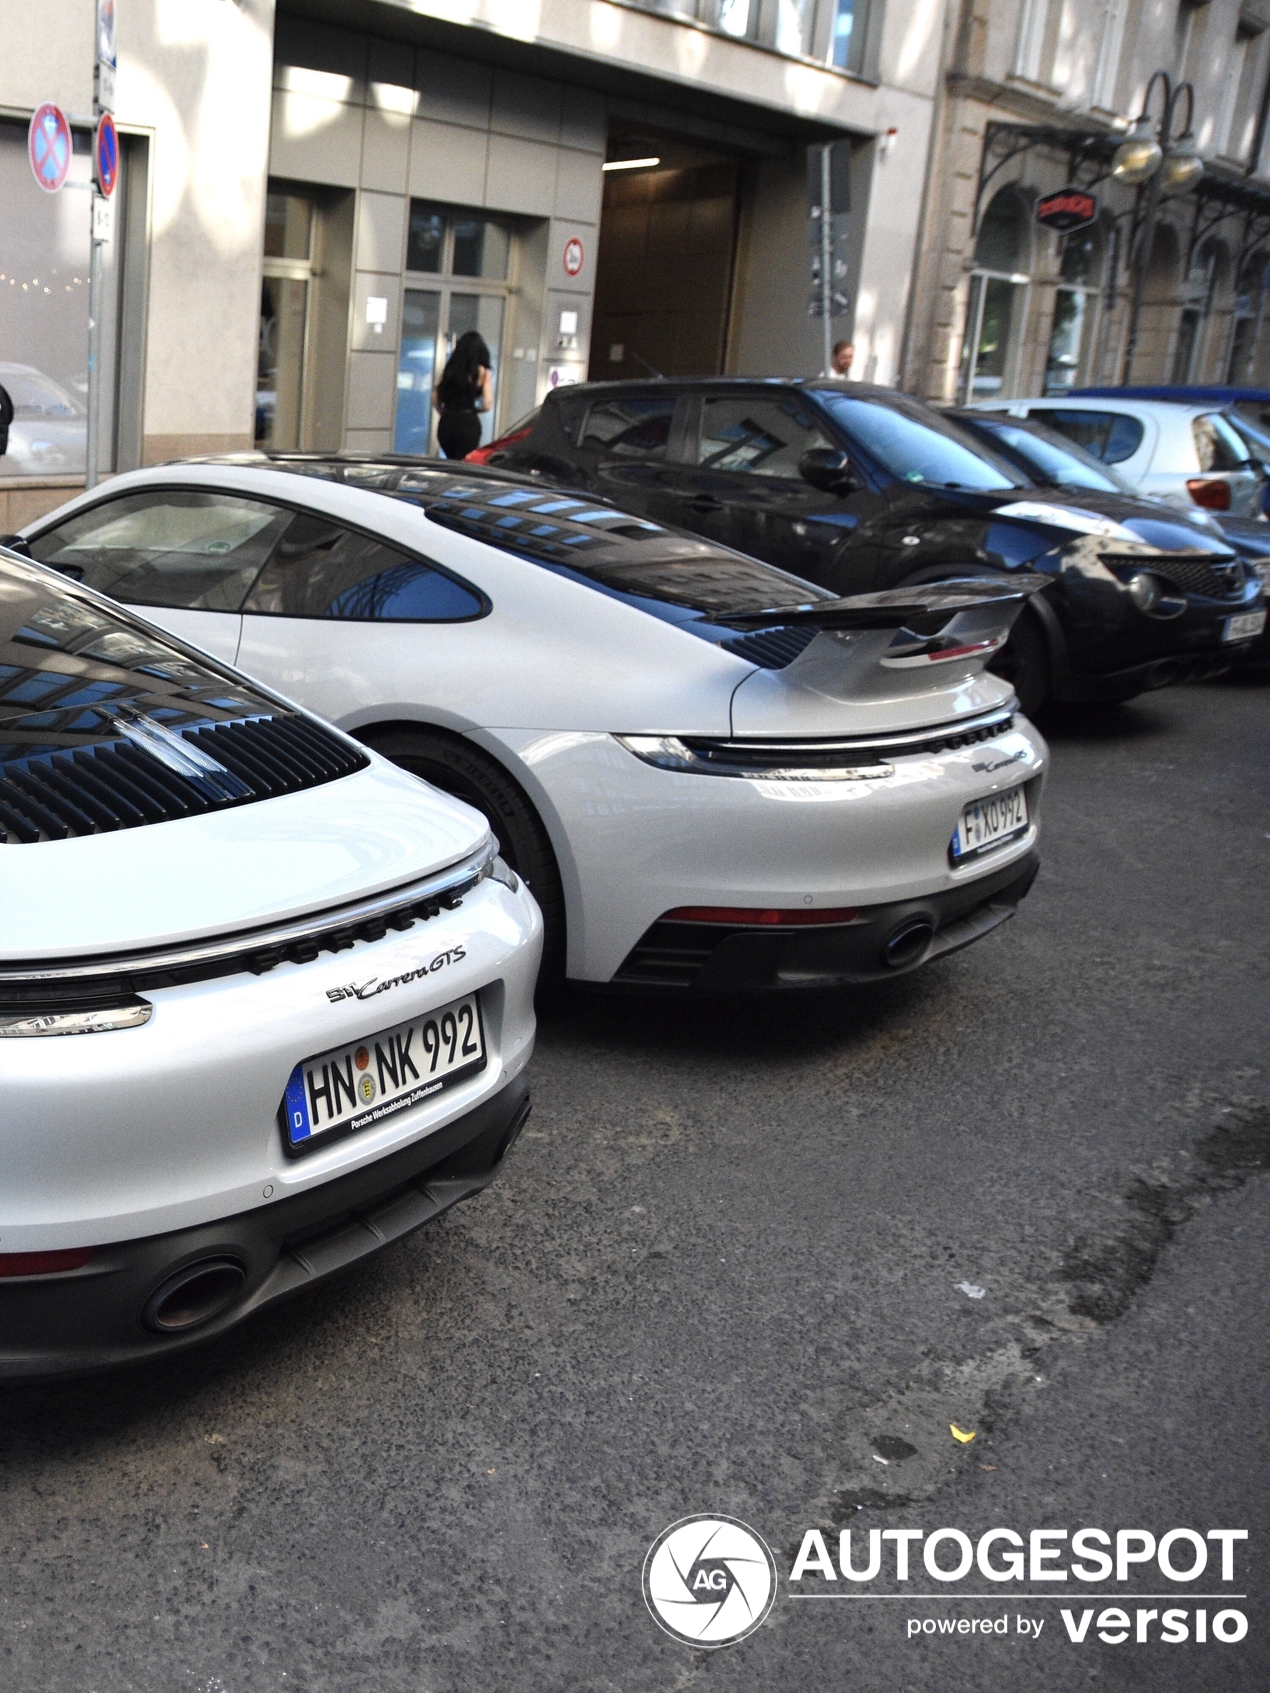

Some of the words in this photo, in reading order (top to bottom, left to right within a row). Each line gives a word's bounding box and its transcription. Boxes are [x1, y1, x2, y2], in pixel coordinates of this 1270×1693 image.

[999, 791, 1023, 829] 992
[325, 981, 360, 1003] 911
[357, 965, 430, 1000] Carrera
[429, 944, 467, 972] GTS
[307, 1054, 357, 1126] HN
[375, 1027, 420, 1095] NK
[422, 1003, 478, 1073] 992
[294, 1111, 303, 1128] D
[351, 1114, 373, 1130] Porsche
[372, 1096, 412, 1120] Werksabholung
[411, 1082, 443, 1103] Zuffenhausen
